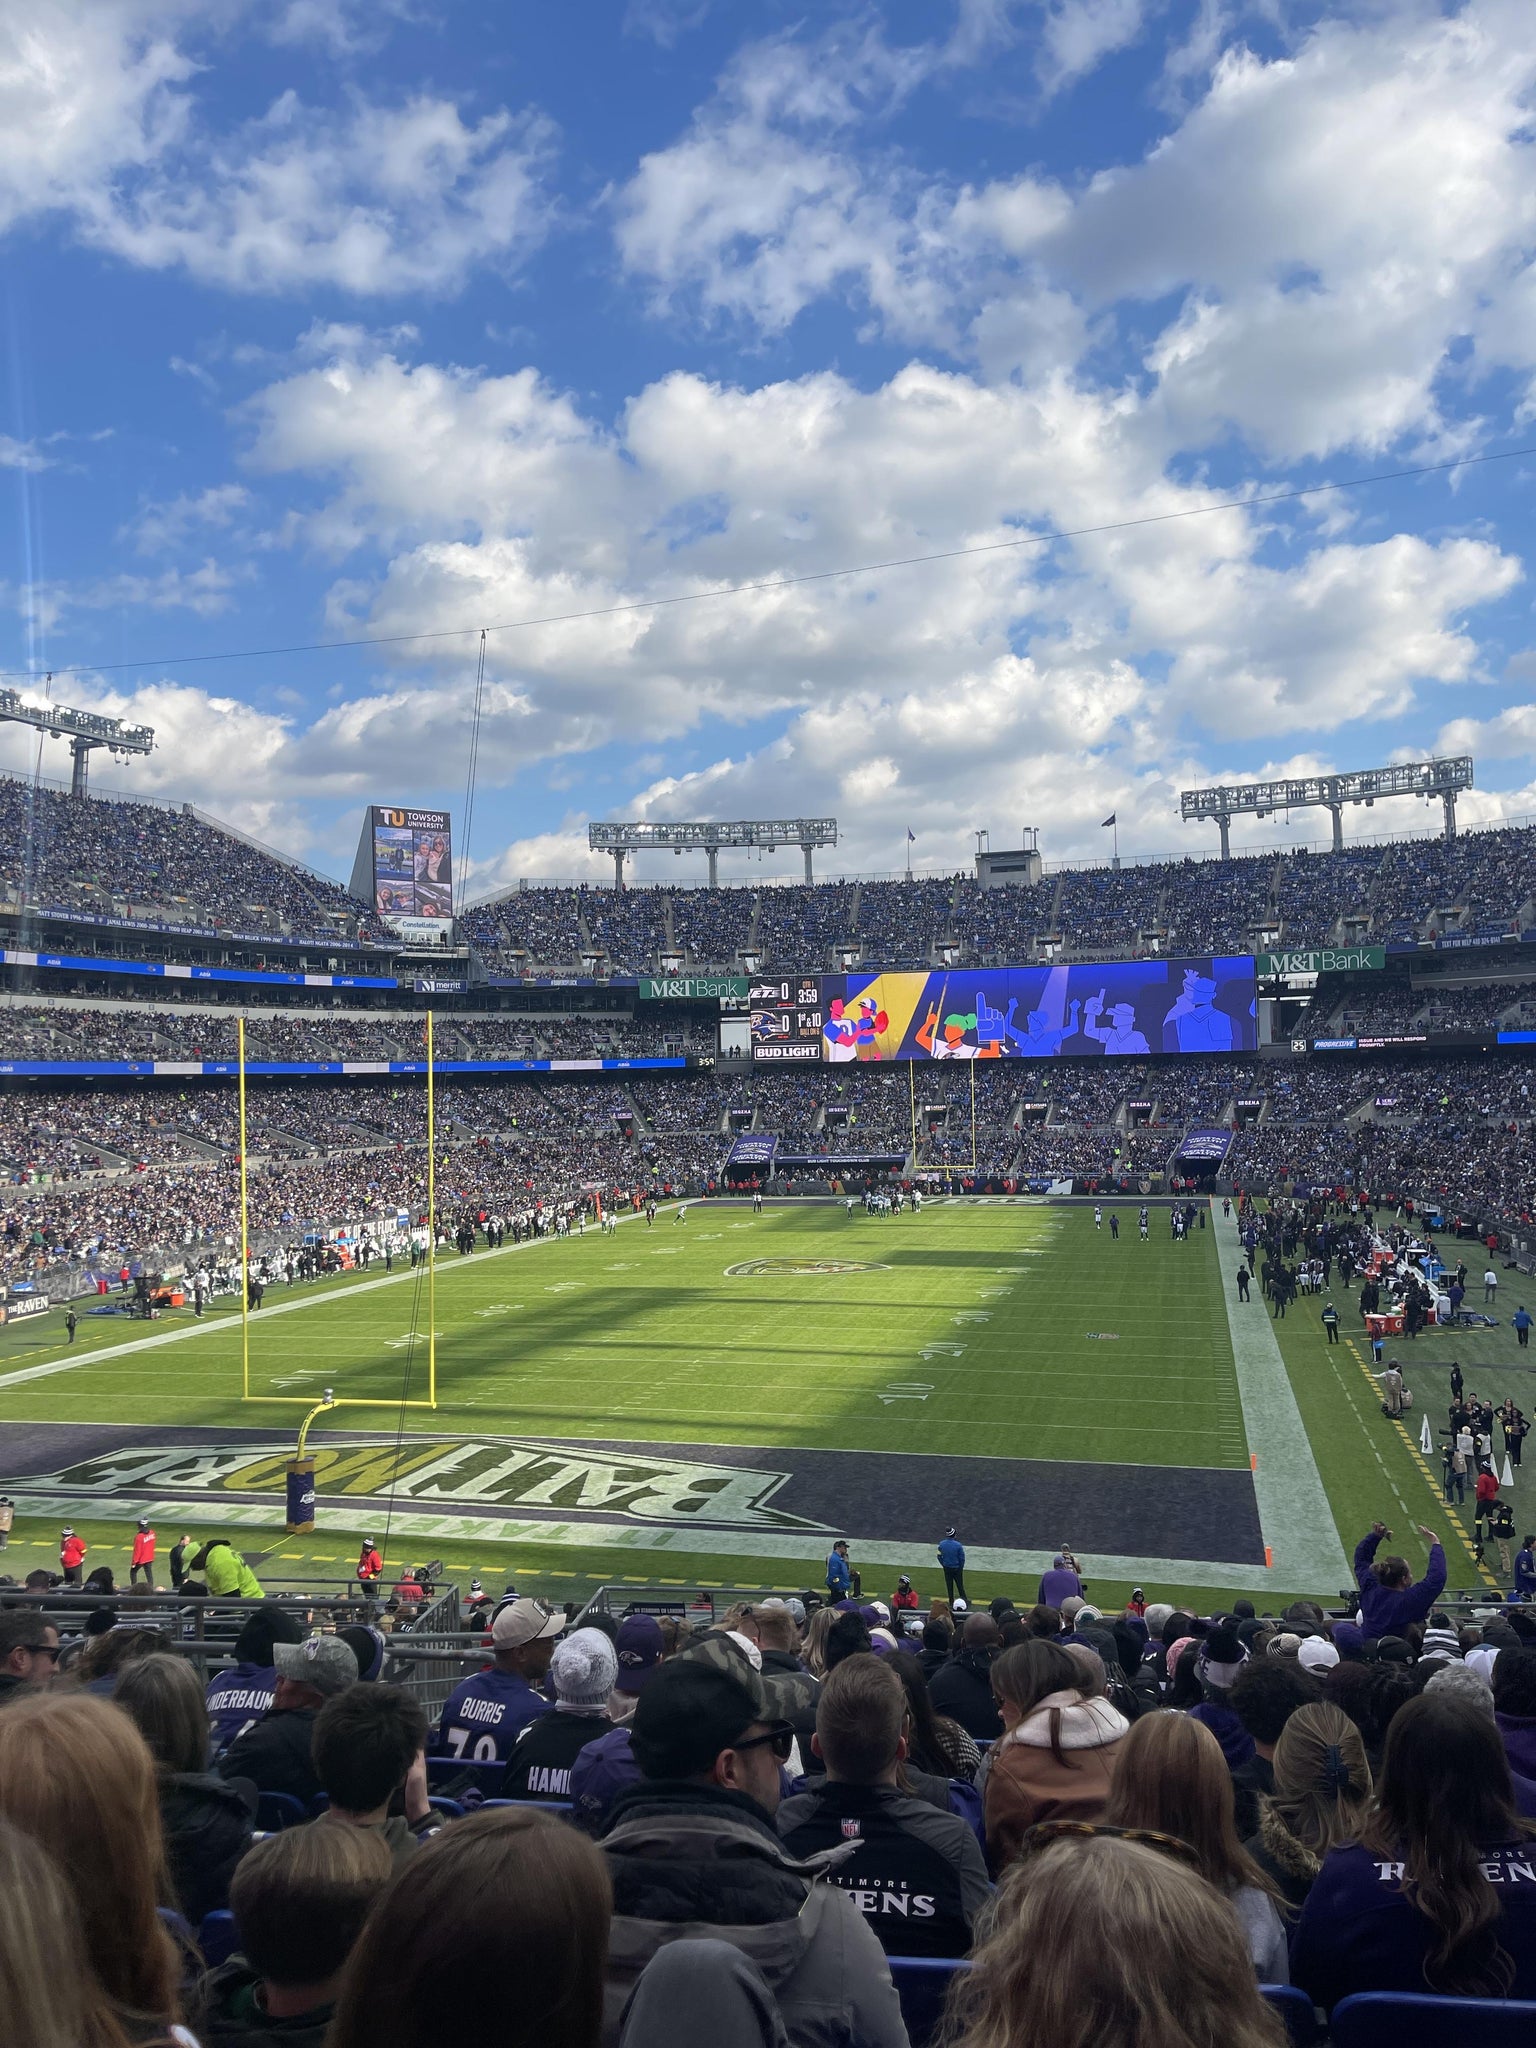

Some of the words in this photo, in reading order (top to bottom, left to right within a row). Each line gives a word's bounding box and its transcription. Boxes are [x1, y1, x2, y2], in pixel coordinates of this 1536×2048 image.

[407, 812, 444, 823] TOWSON
[407, 820, 444, 830] UNIVERSITY
[106, 918, 121, 926] JAMAL
[168, 925, 181, 933] TODD
[1268, 952, 1321, 974] M&T
[1322, 951, 1372, 971] Bank
[436, 981, 461, 989] merritt
[649, 979, 695, 998] M&T
[696, 979, 738, 997] Bank
[781, 982, 789, 1000] 0
[798, 989, 818, 1004] 3:59
[782, 1014, 790, 1032] 0
[1292, 1041, 1305, 1051] 25
[1314, 1040, 1356, 1049] PROGRESSIVE
[756, 1047, 782, 1058] BUD
[782, 1047, 817, 1057] LIGHT
[7, 1305, 18, 1314] THE
[876, 1382, 936, 1402] 10
[357, 1513, 571, 1541] TAKES
[604, 1528, 678, 1547] IT
[459, 1697, 506, 1724] BURRIS
[842, 1823, 860, 1836] NFL
